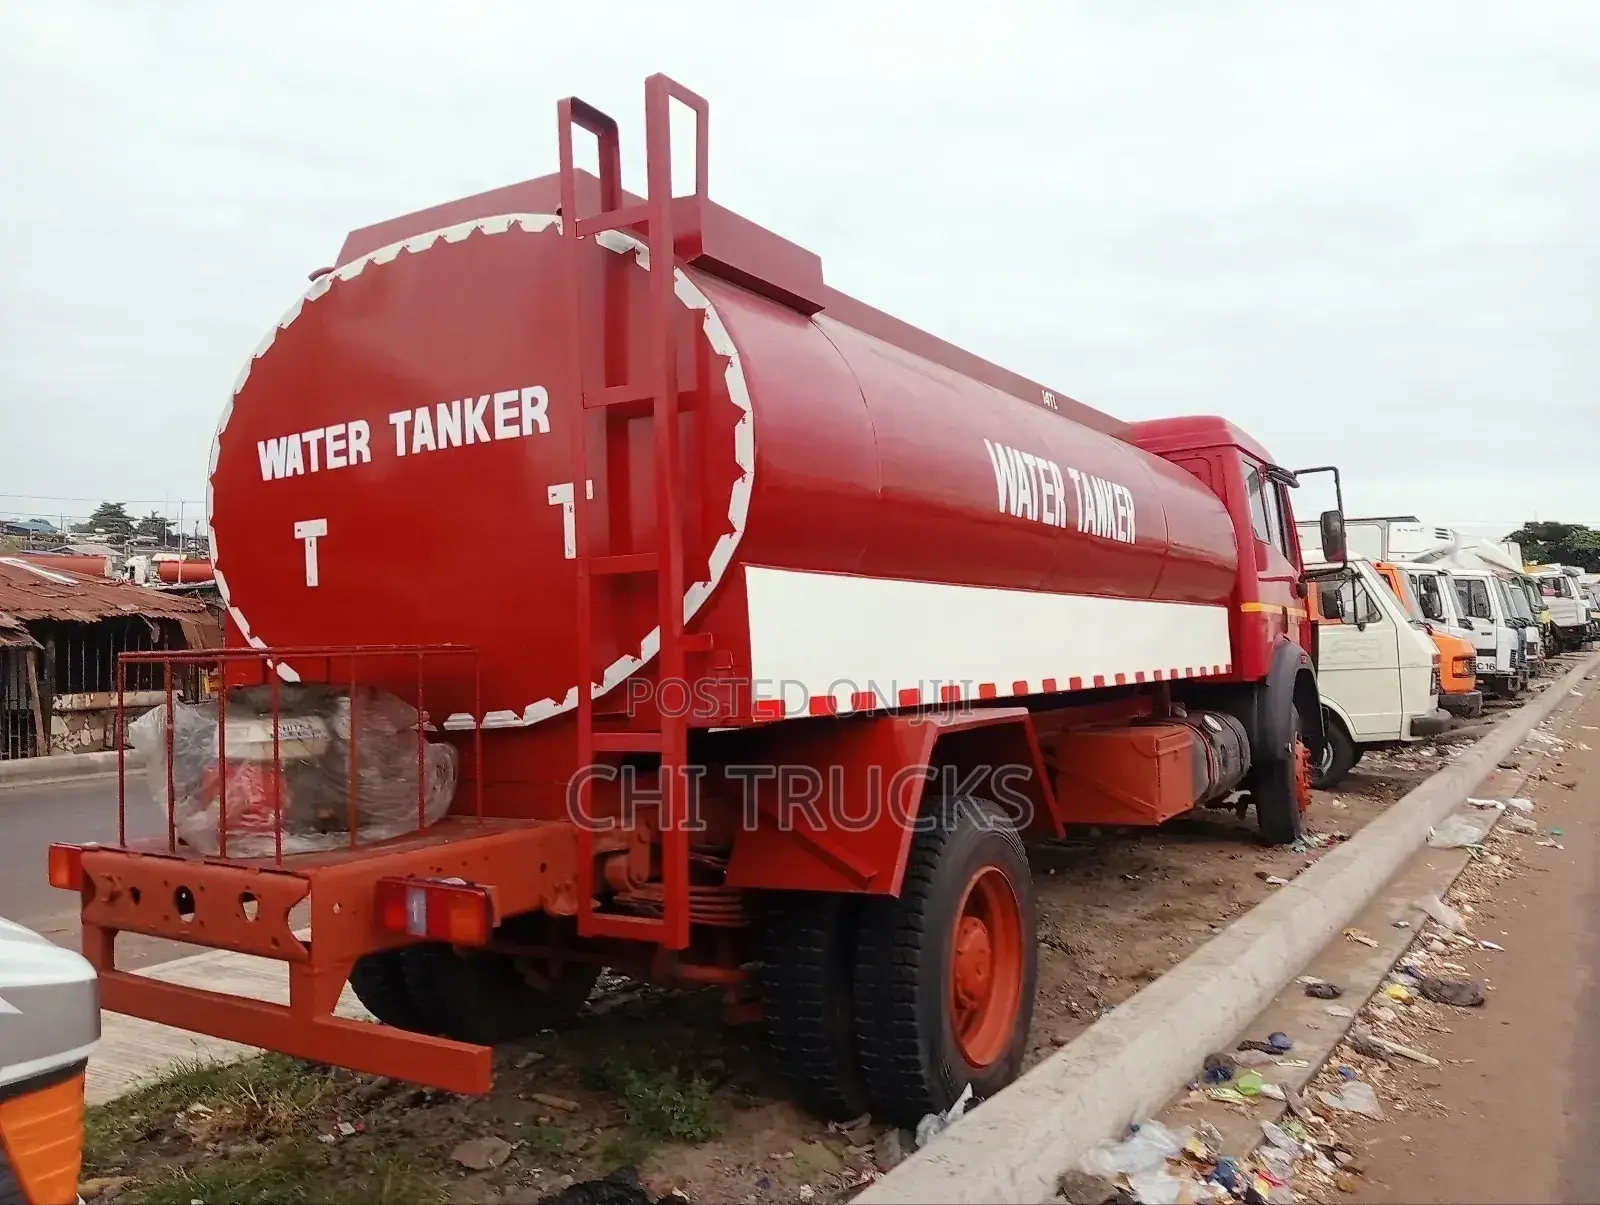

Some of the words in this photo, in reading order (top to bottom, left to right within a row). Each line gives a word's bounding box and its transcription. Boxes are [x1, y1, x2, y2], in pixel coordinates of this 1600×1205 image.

[257, 420, 371, 481] WATER
[389, 385, 550, 457] TANKER
[983, 438, 1067, 529] WATER
[1067, 467, 1136, 545] TANKER
